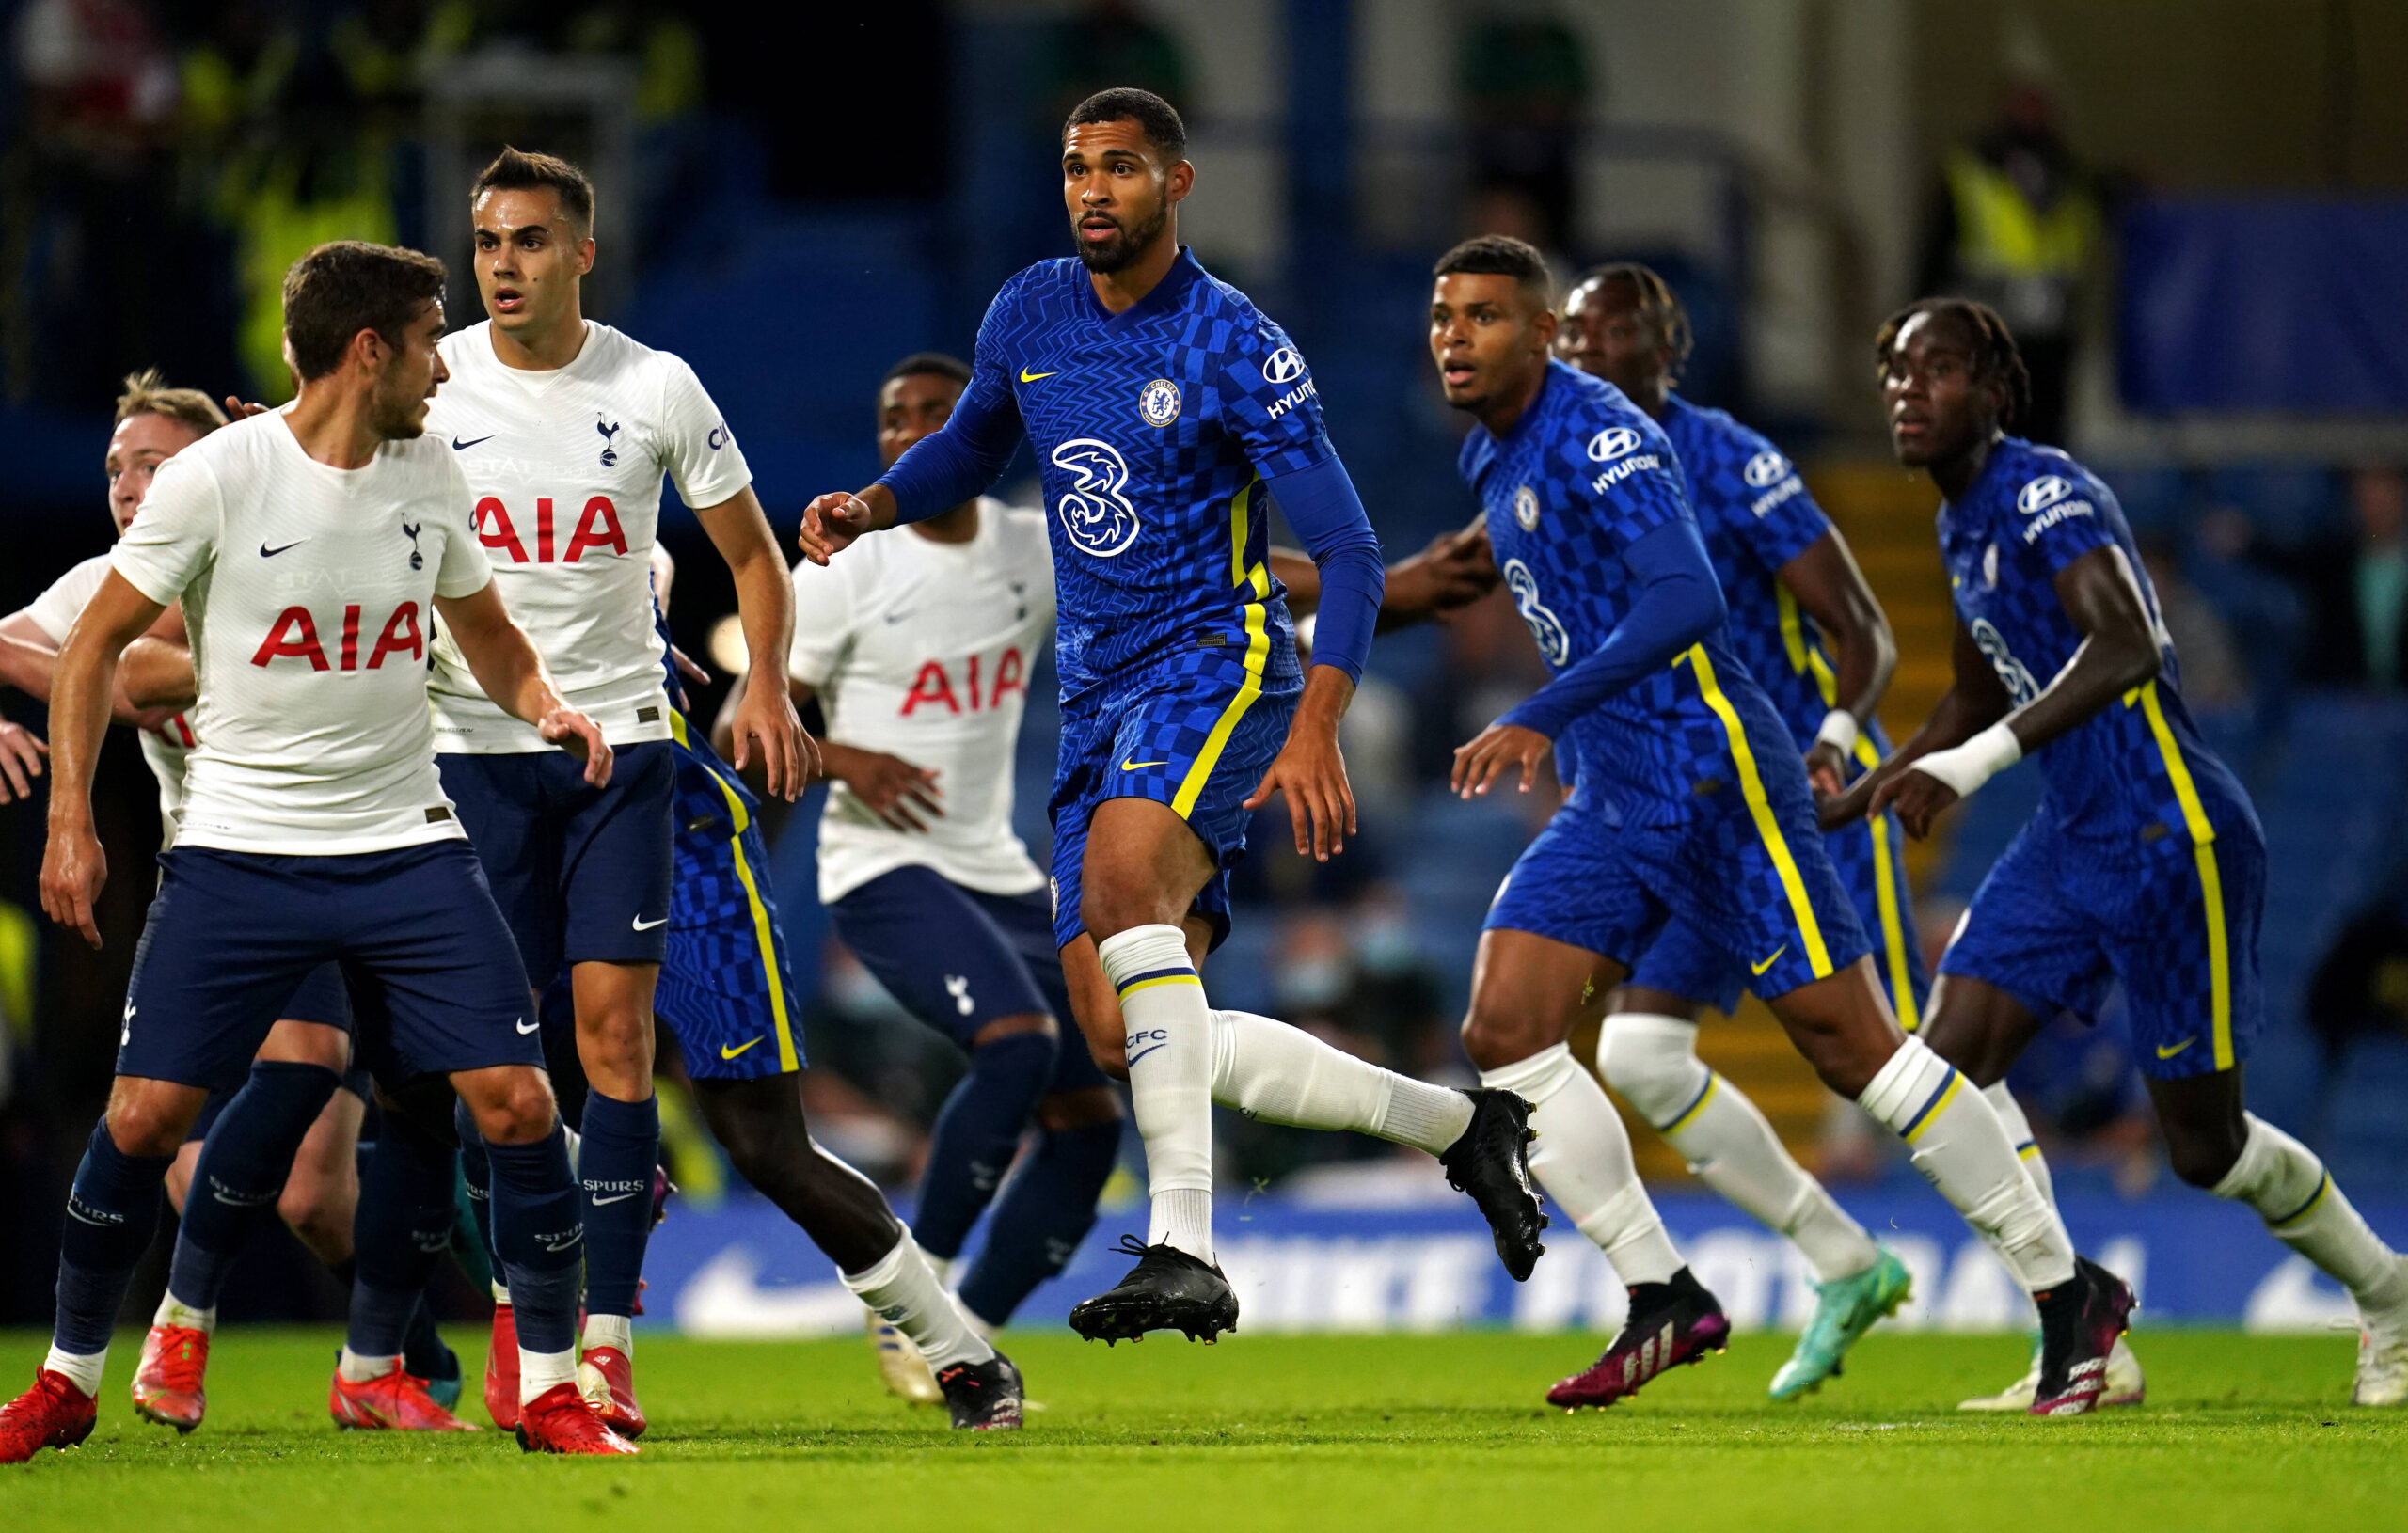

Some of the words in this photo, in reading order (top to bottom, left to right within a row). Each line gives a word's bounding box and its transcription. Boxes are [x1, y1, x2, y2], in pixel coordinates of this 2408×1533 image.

[475, 496, 628, 563] AIA
[1052, 438, 1140, 558] 3
[250, 600, 423, 672] AIA
[898, 646, 1028, 718] AIA
[1125, 1028, 1168, 1050] CFC
[583, 1178, 645, 1193] SPURS
